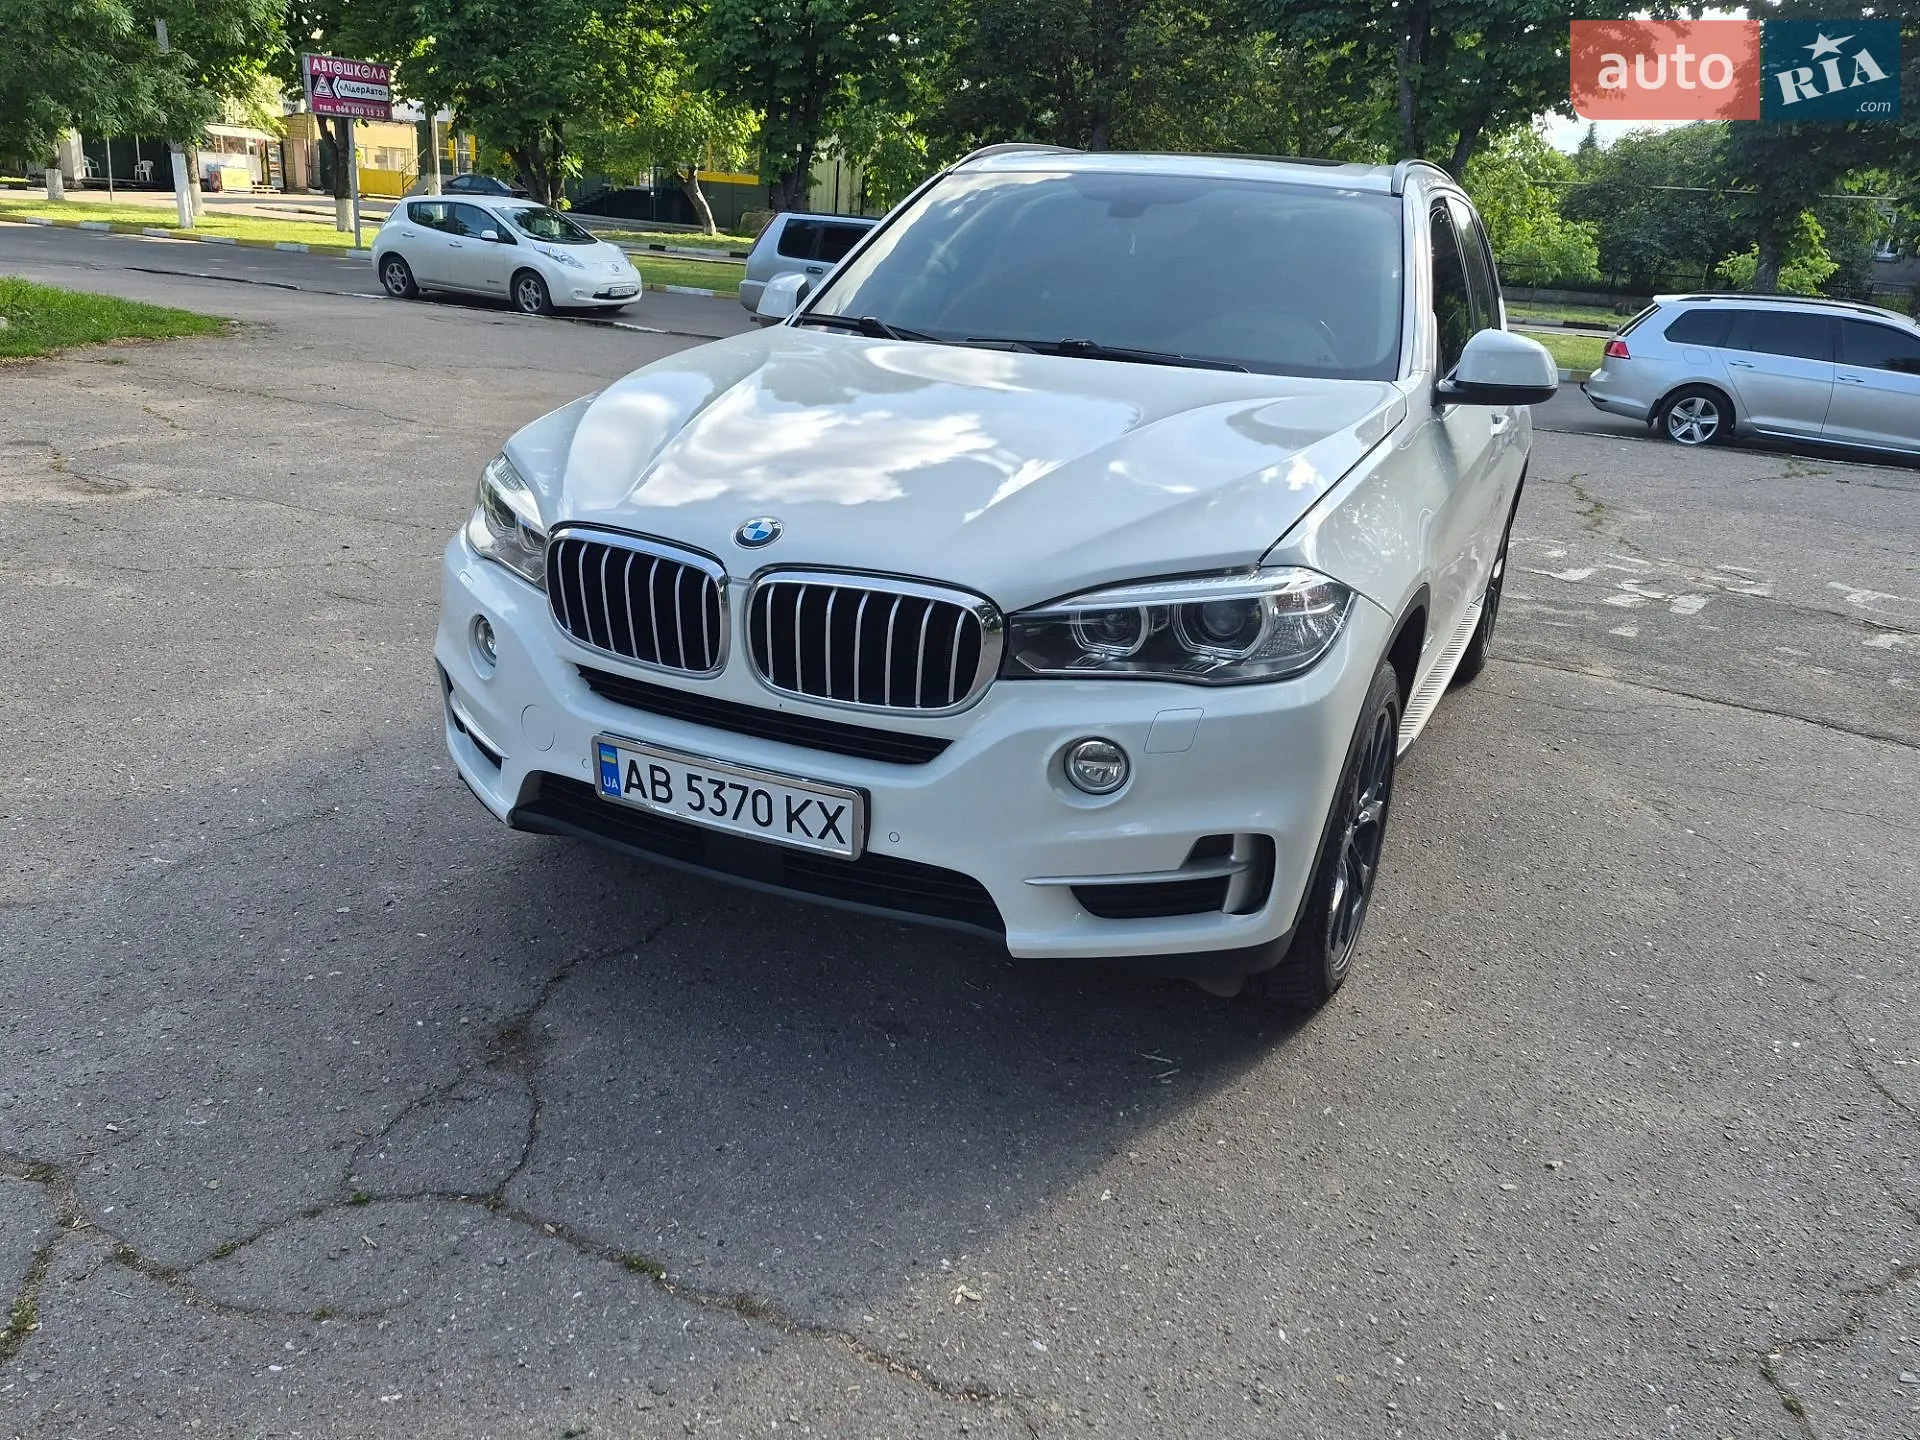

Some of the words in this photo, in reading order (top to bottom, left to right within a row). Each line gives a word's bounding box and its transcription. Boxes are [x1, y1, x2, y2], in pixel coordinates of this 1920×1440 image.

[312, 58, 387, 80] АВТОШКОЛА
[603, 775, 619, 790] UA
[624, 759, 673, 804] AB
[686, 772, 773, 827] 5370
[785, 795, 846, 845] KX
